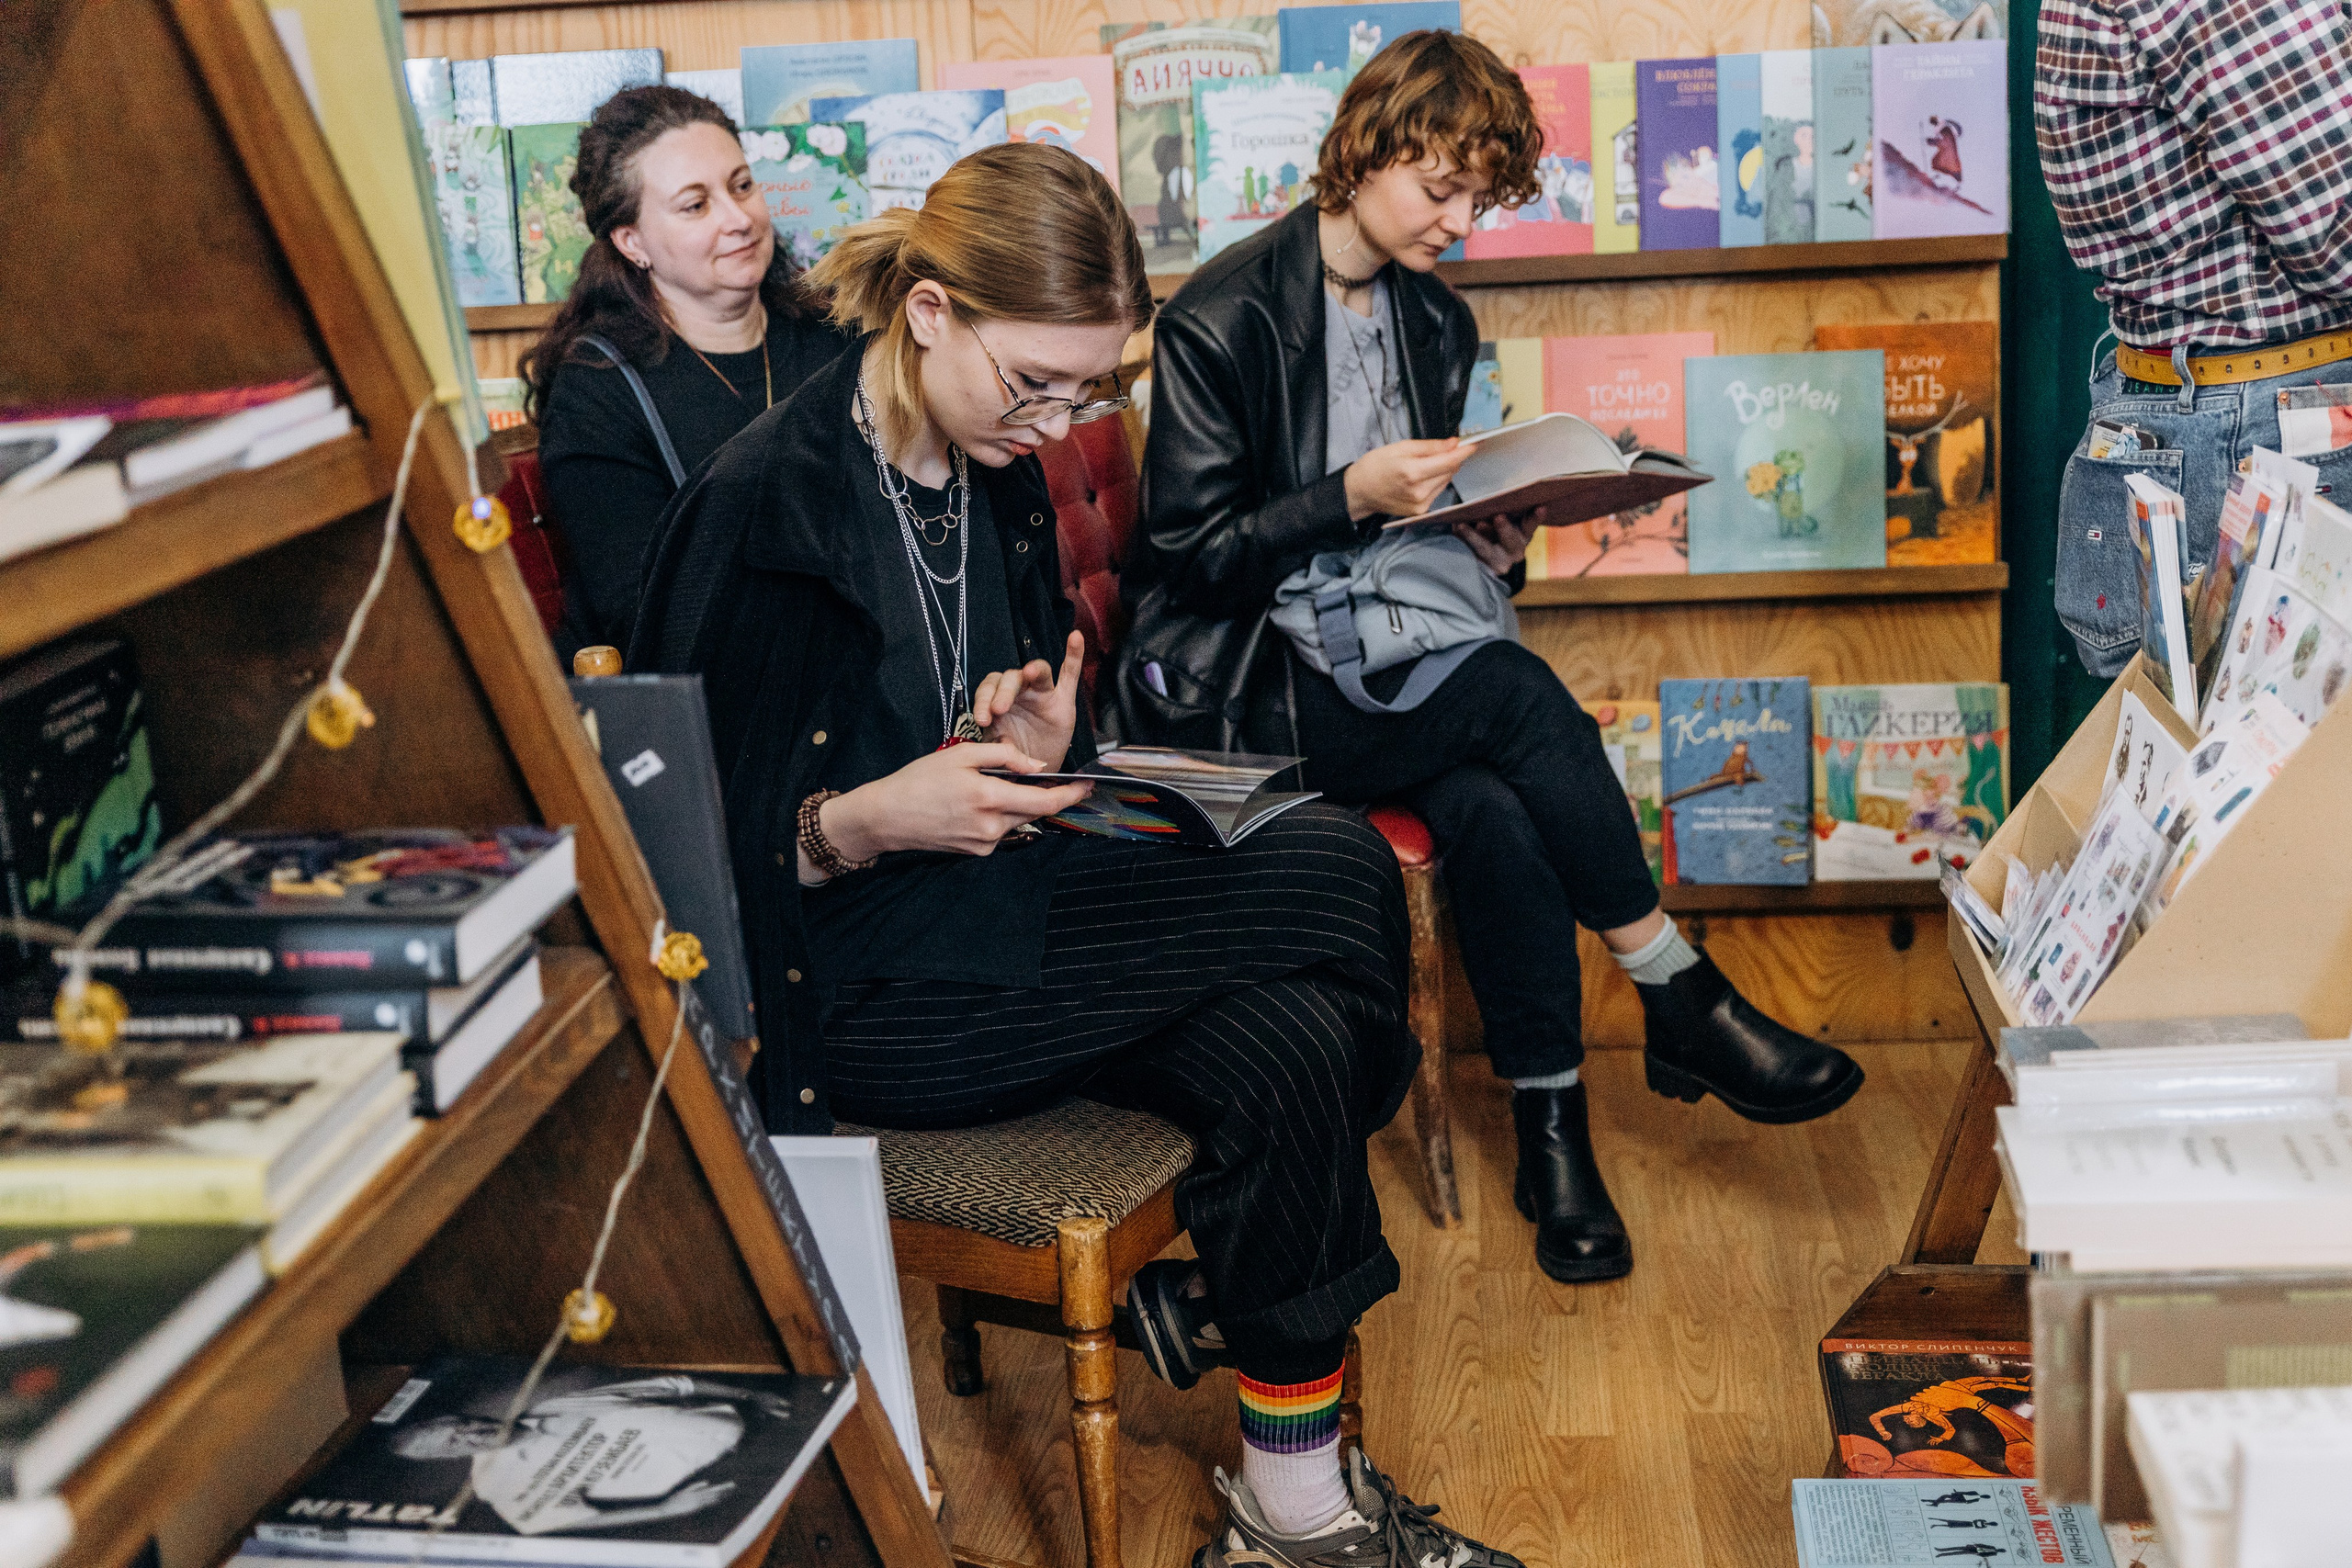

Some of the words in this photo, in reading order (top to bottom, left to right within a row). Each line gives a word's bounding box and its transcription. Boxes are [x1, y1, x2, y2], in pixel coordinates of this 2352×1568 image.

[1898, 355, 1946, 372] ХОЧУ
[1586, 381, 1671, 406] ТОЧНО
[1724, 380, 1840, 430] Верлен
[1888, 401, 1938, 419] ЕЛКОЙ
[1845, 1342, 1909, 1351] ВИКТОР
[1917, 1343, 2018, 1353] СЛИПЕНЧУК
[2030, 1518, 2065, 1564] ЖЕСТОВ
[2058, 1506, 2094, 1566] РЕМЕННЫЙ
